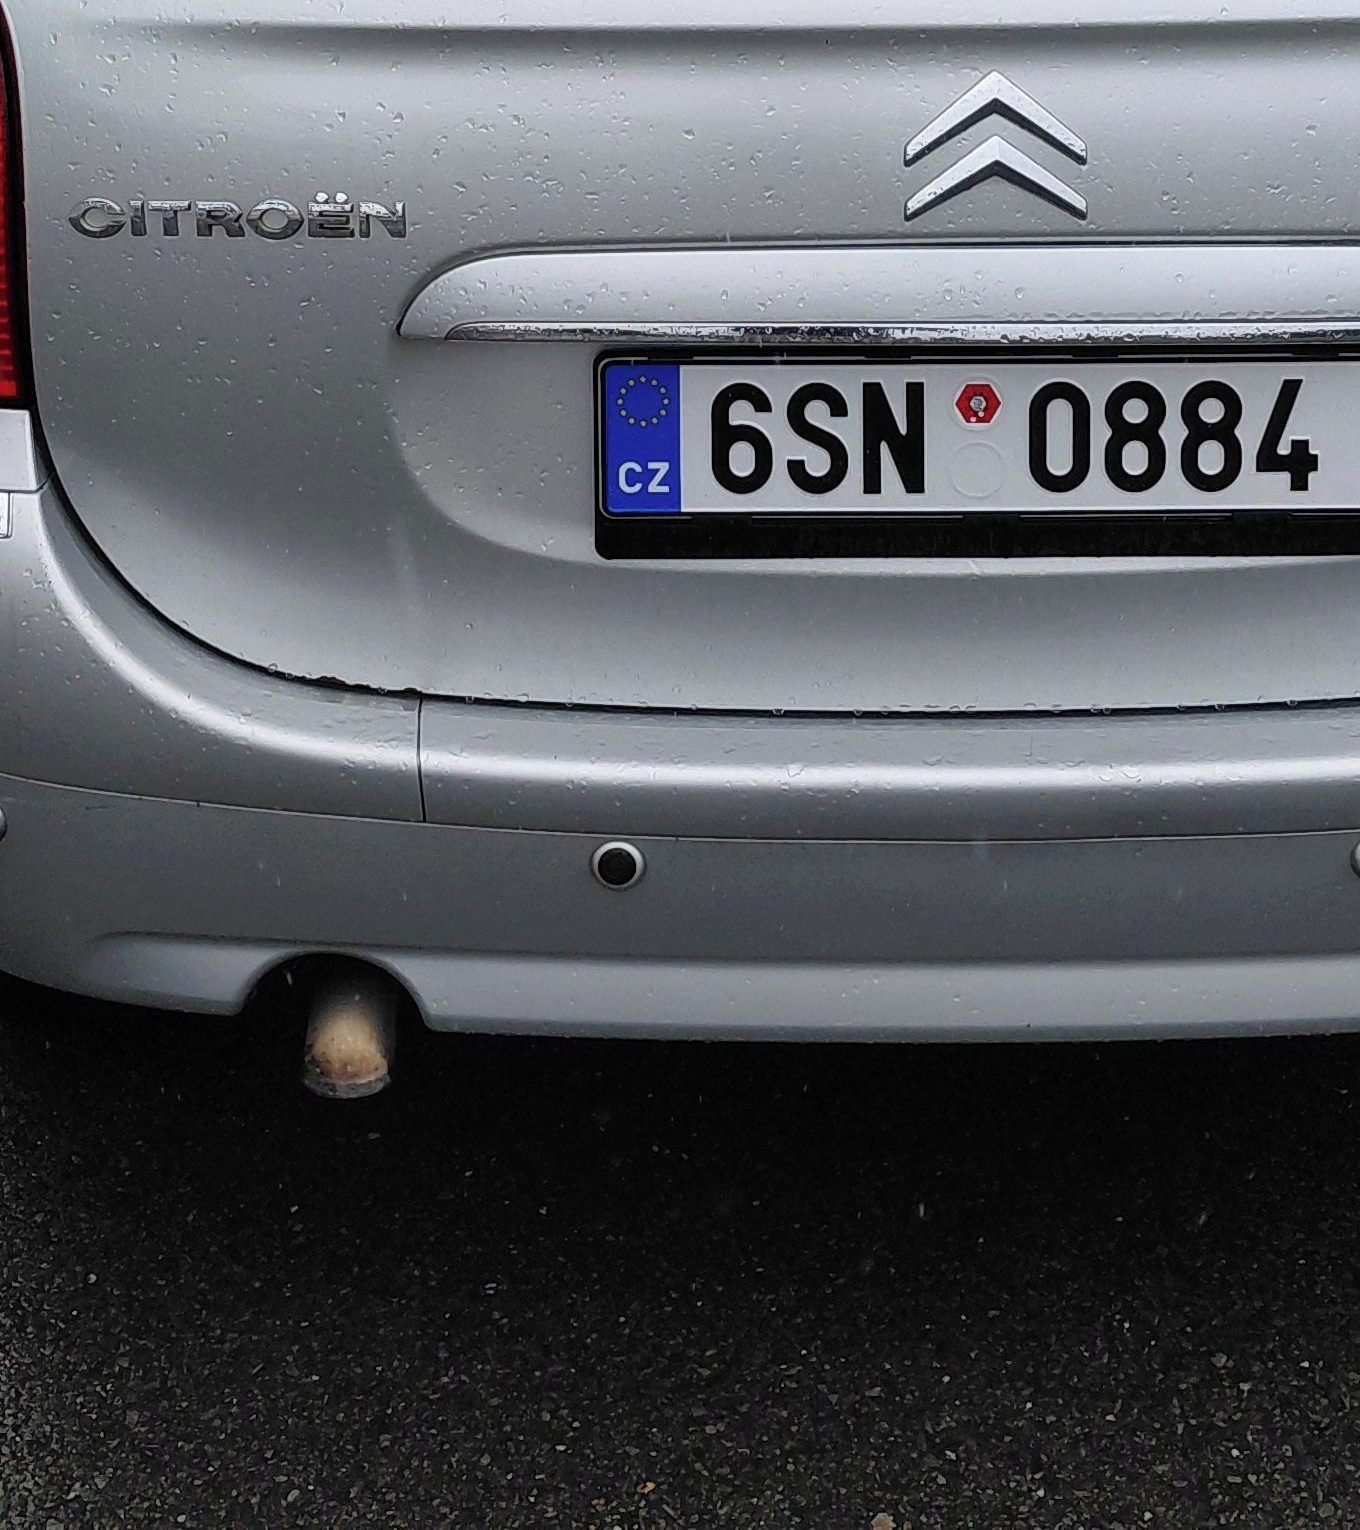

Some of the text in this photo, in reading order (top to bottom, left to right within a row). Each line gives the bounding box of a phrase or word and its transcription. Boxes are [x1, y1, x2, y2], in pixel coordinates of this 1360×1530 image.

[69, 191, 408, 241] CITROËN
[710, 378, 1320, 495] 6SN 0884
[617, 461, 671, 495] CZ
